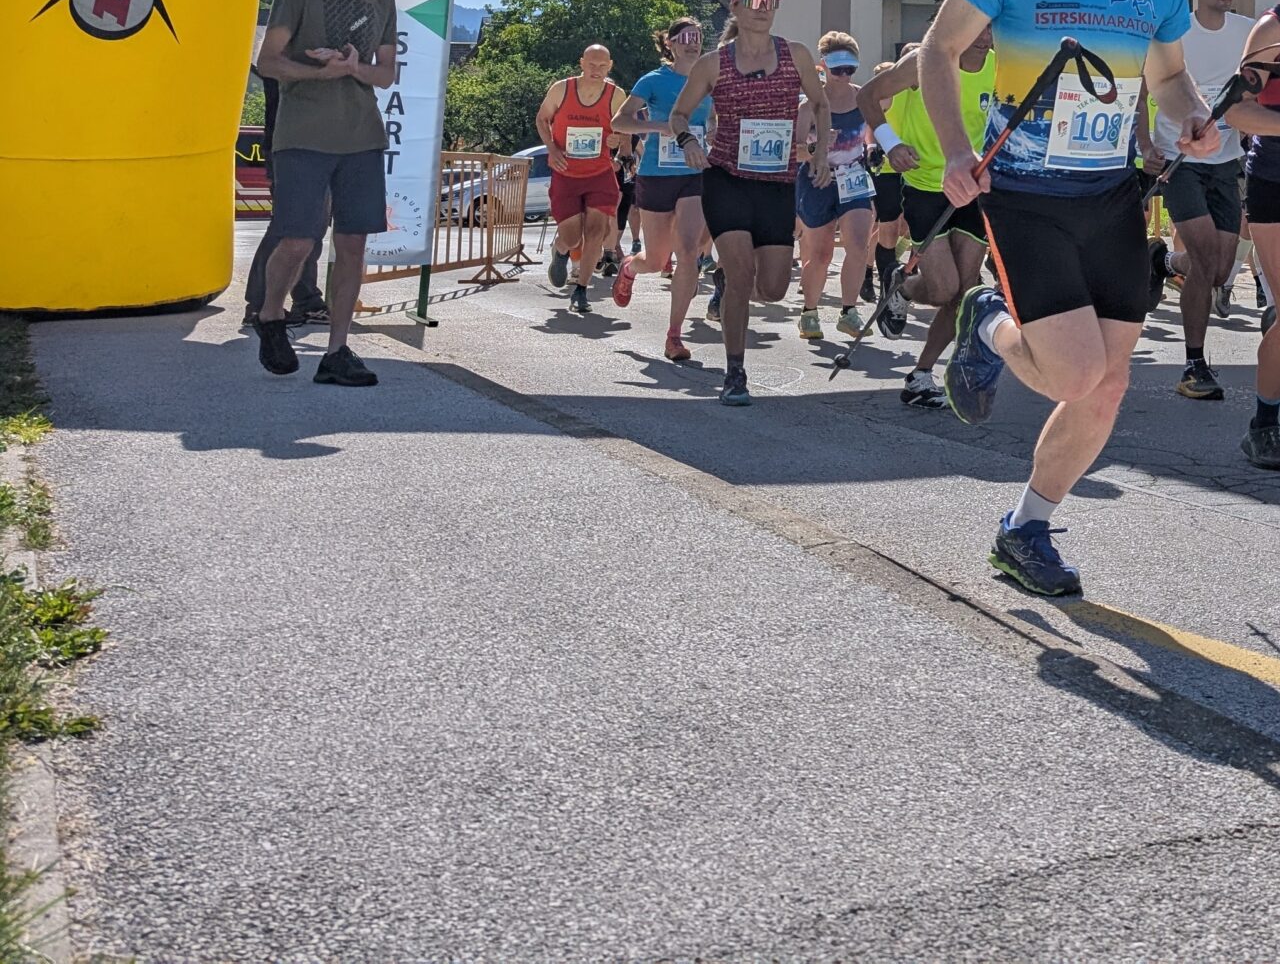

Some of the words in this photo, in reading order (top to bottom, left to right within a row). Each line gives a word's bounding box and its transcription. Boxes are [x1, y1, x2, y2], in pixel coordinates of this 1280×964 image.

[383, 31, 409, 175] START
[1077, 101, 1088, 110] TEK
[1072, 111, 1122, 143] 108
[752, 140, 783, 157] 140
[366, 245, 407, 256] ELEZNIKI
